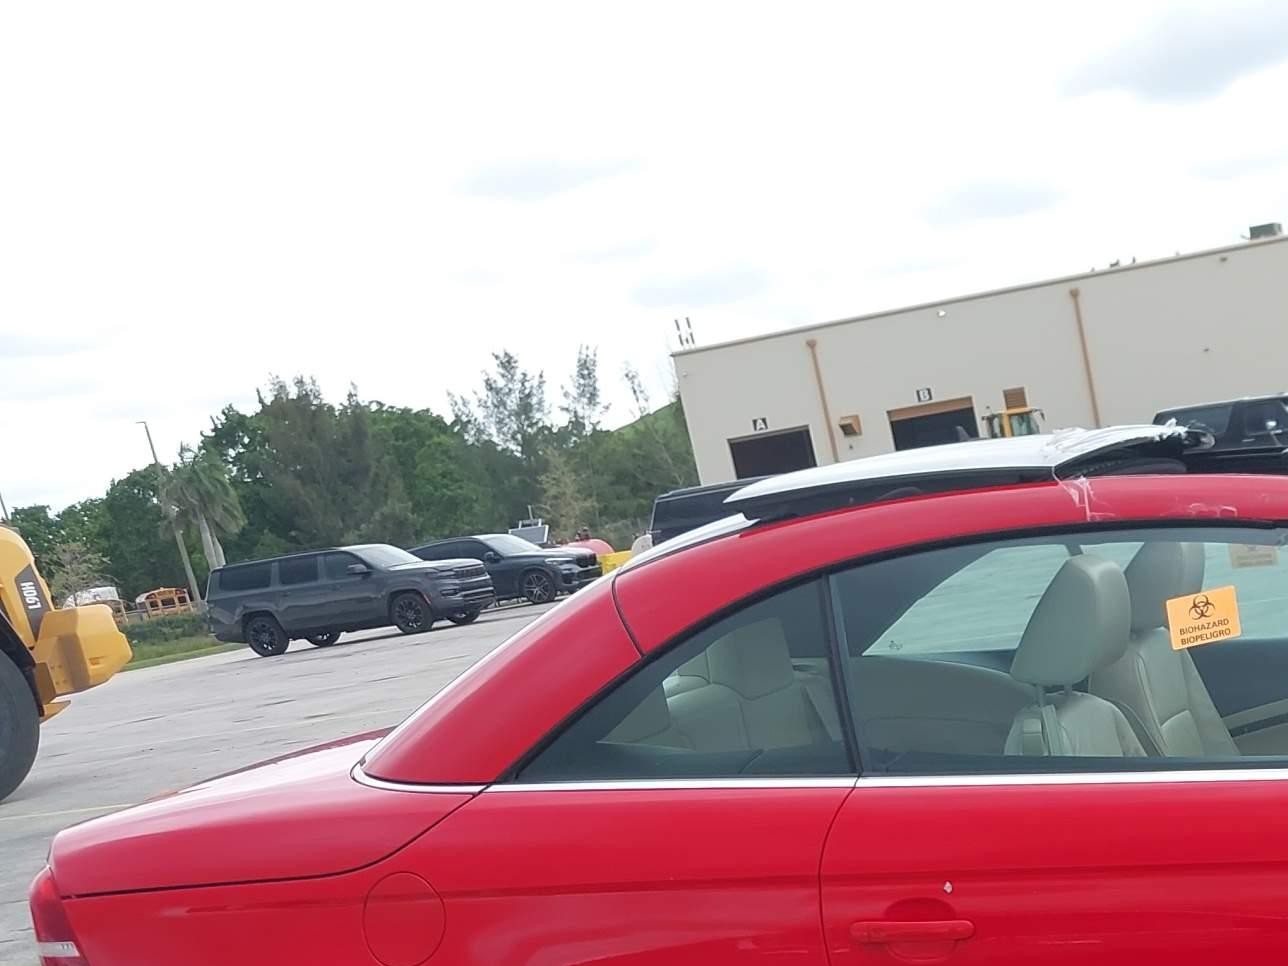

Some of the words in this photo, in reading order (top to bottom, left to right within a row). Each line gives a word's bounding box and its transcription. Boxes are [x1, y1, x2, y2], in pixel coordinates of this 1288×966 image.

[20, 581, 42, 610] L90H
[1179, 618, 1230, 636] BIOHAZARD
[1180, 627, 1232, 646] BIOPELIGRO
